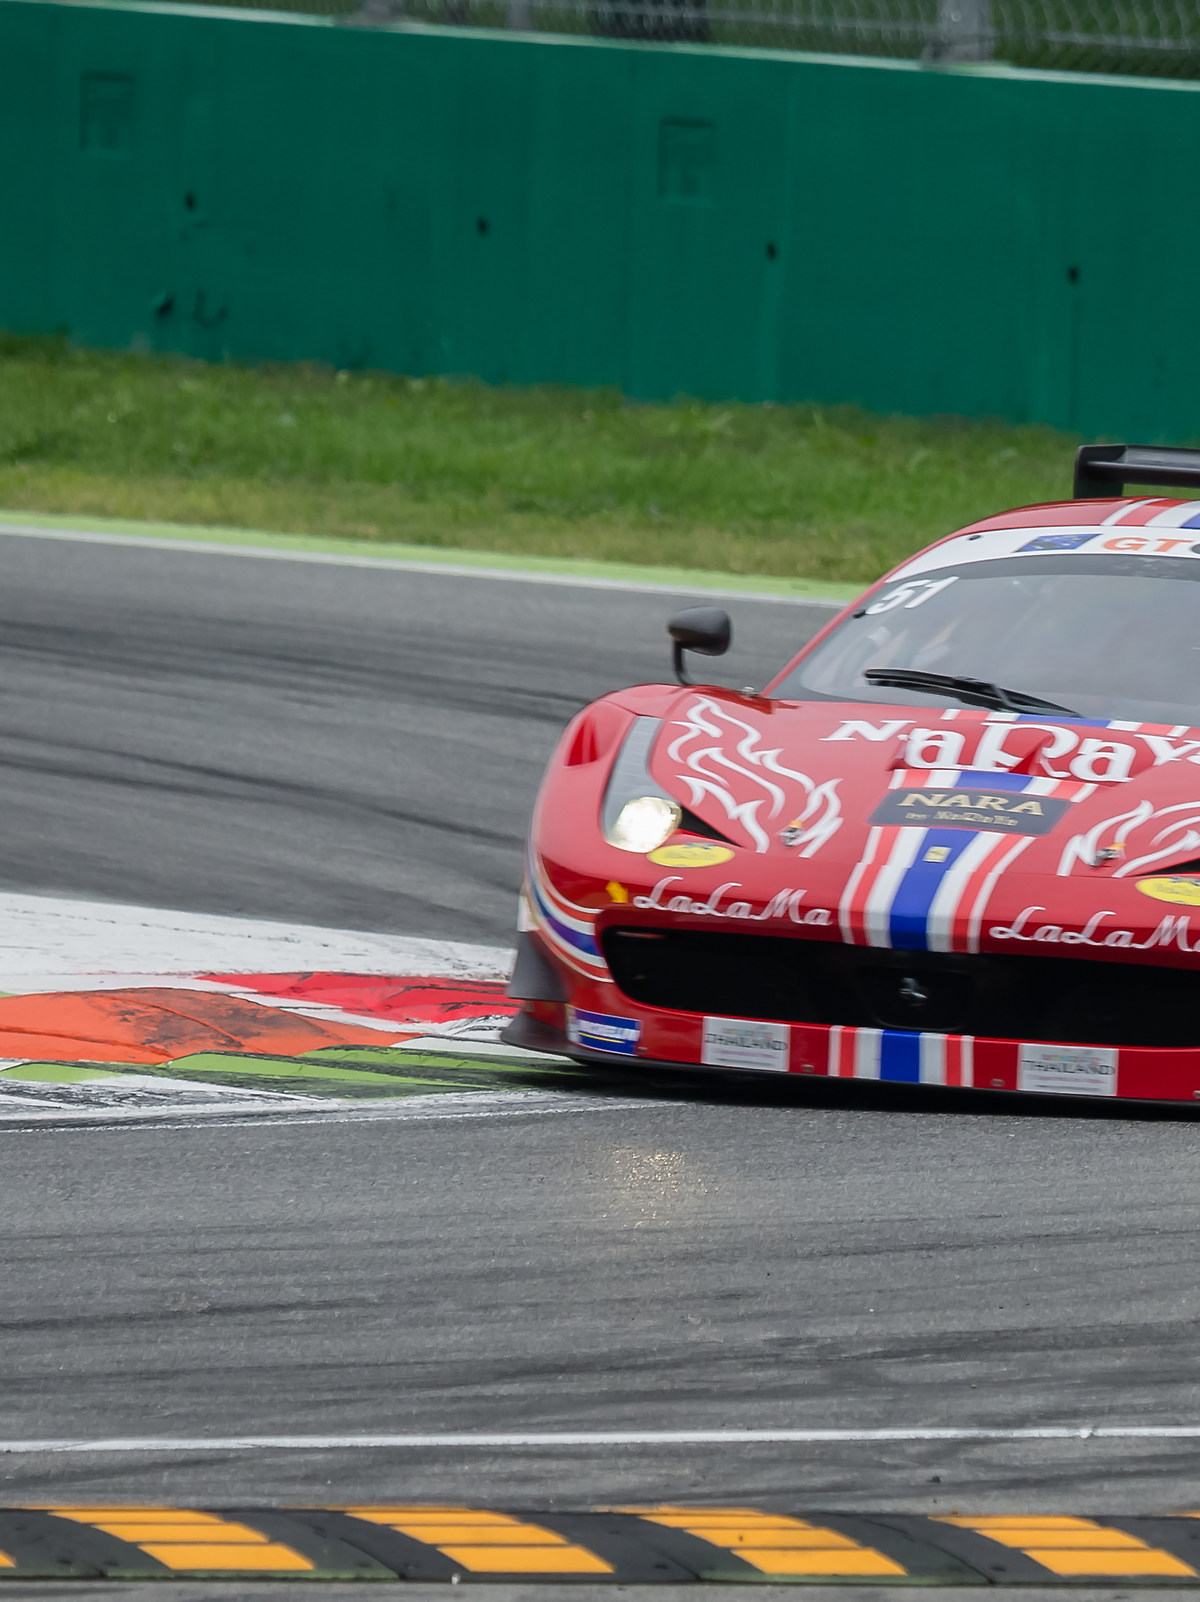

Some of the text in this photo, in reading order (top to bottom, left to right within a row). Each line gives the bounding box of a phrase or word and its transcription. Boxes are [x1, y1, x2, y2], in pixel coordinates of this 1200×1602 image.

[865, 576, 960, 615] 51
[896, 793, 1045, 816] NARA
[1021, 1059, 1116, 1076] THAILAND
